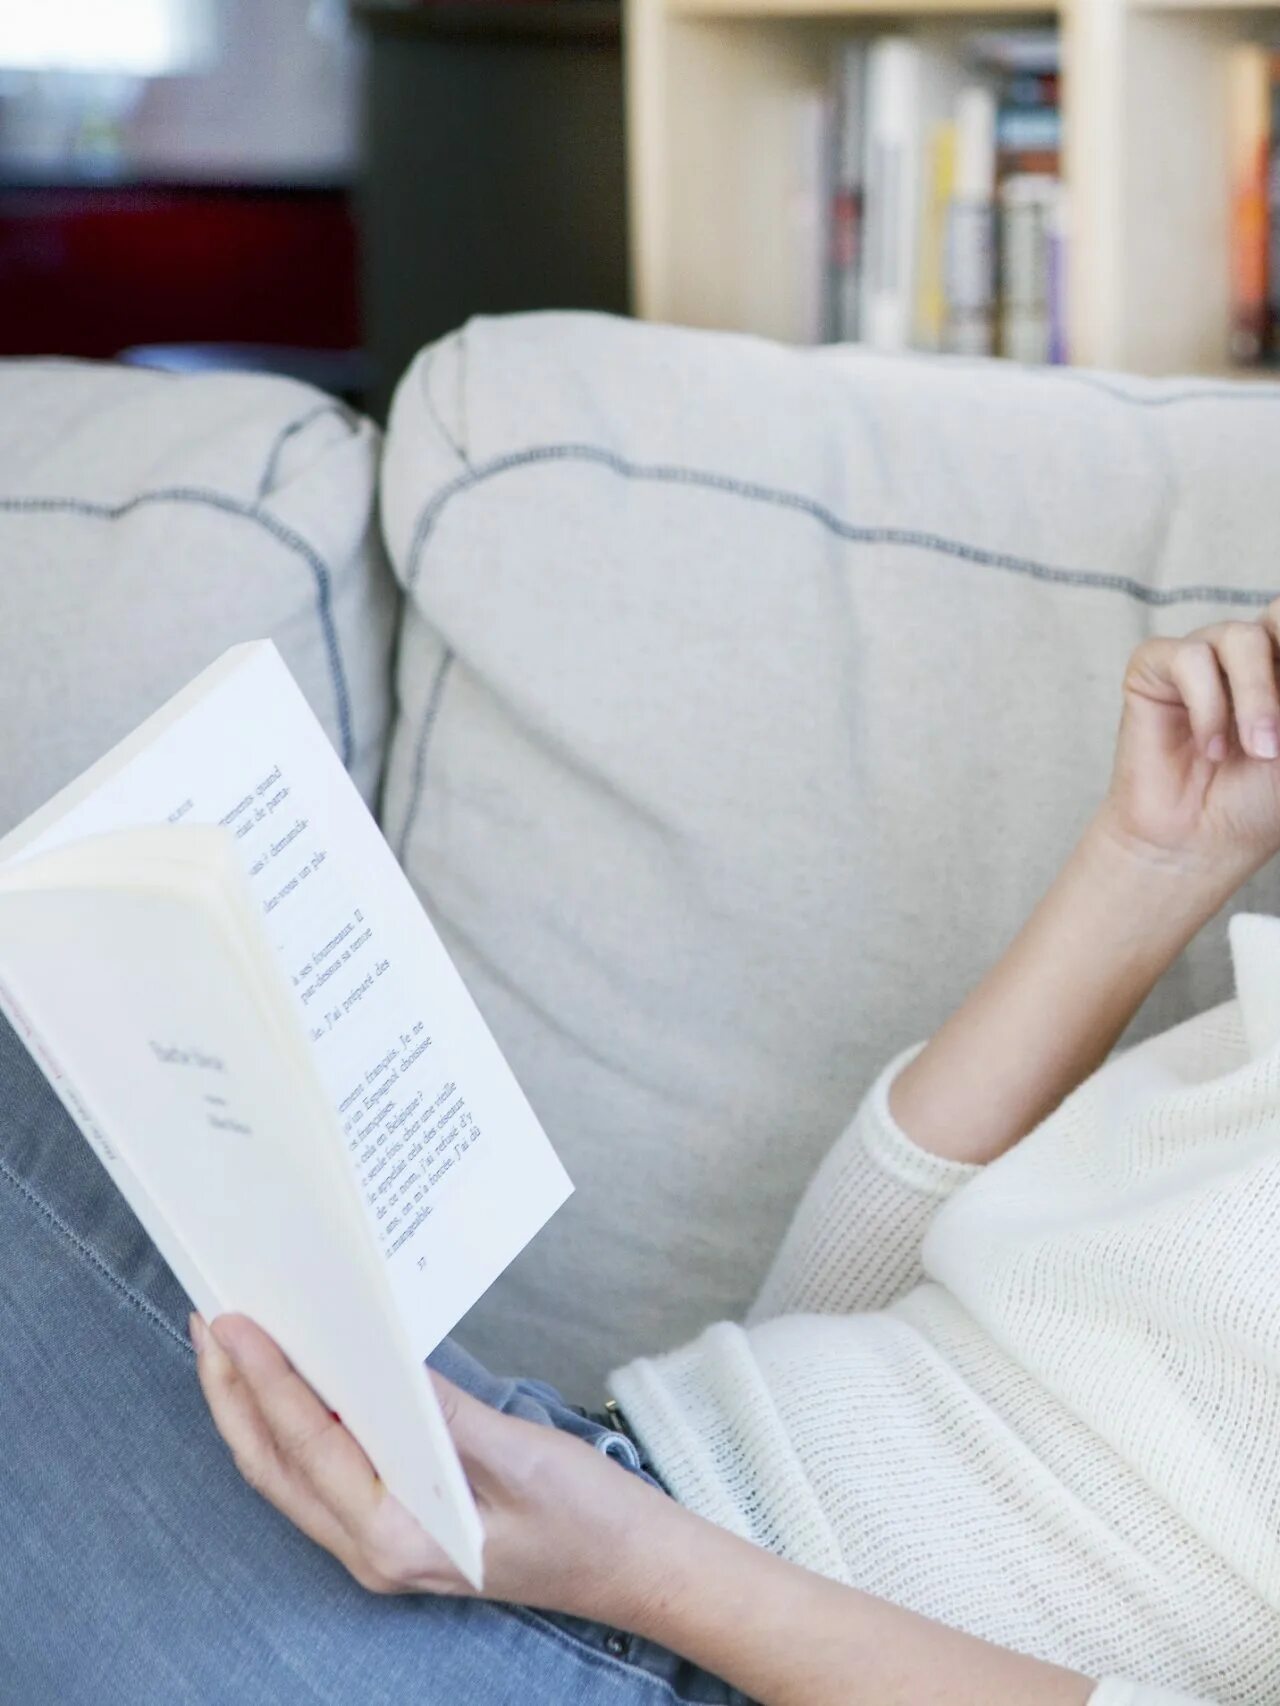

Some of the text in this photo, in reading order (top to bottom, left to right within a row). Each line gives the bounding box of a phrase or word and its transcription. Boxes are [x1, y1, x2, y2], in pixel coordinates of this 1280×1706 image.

[256, 764, 282, 797] quand
[255, 807, 266, 822] de
[270, 818, 309, 857] demanda-
[298, 866, 312, 880] un
[341, 950, 351, 962] sa
[349, 928, 373, 953] tenue
[299, 963, 313, 976] ses
[324, 1006, 342, 1031] J'ai
[341, 973, 375, 1014] préparé
[375, 959, 390, 977] des
[400, 1035, 412, 1050] Je
[412, 1021, 424, 1035] ne
[362, 1068, 399, 1110] Espagnol
[400, 1037, 432, 1072] choisisse
[368, 1157, 387, 1181] seule
[403, 1121, 421, 1142] chez
[421, 1106, 435, 1122] une
[435, 1082, 456, 1106] vieille
[377, 1133, 387, 1146] en
[378, 1160, 407, 1195] appelait
[408, 1143, 422, 1161] cela
[423, 1128, 436, 1144] des
[438, 1097, 465, 1129] oiseaux
[389, 1194, 398, 1207] ce
[435, 1127, 459, 1156] refusé
[460, 1112, 473, 1128] d'y
[402, 1202, 413, 1216] on
[414, 1185, 429, 1203] m'a
[454, 1141, 469, 1160] J'ai
[470, 1126, 481, 1142] dû
